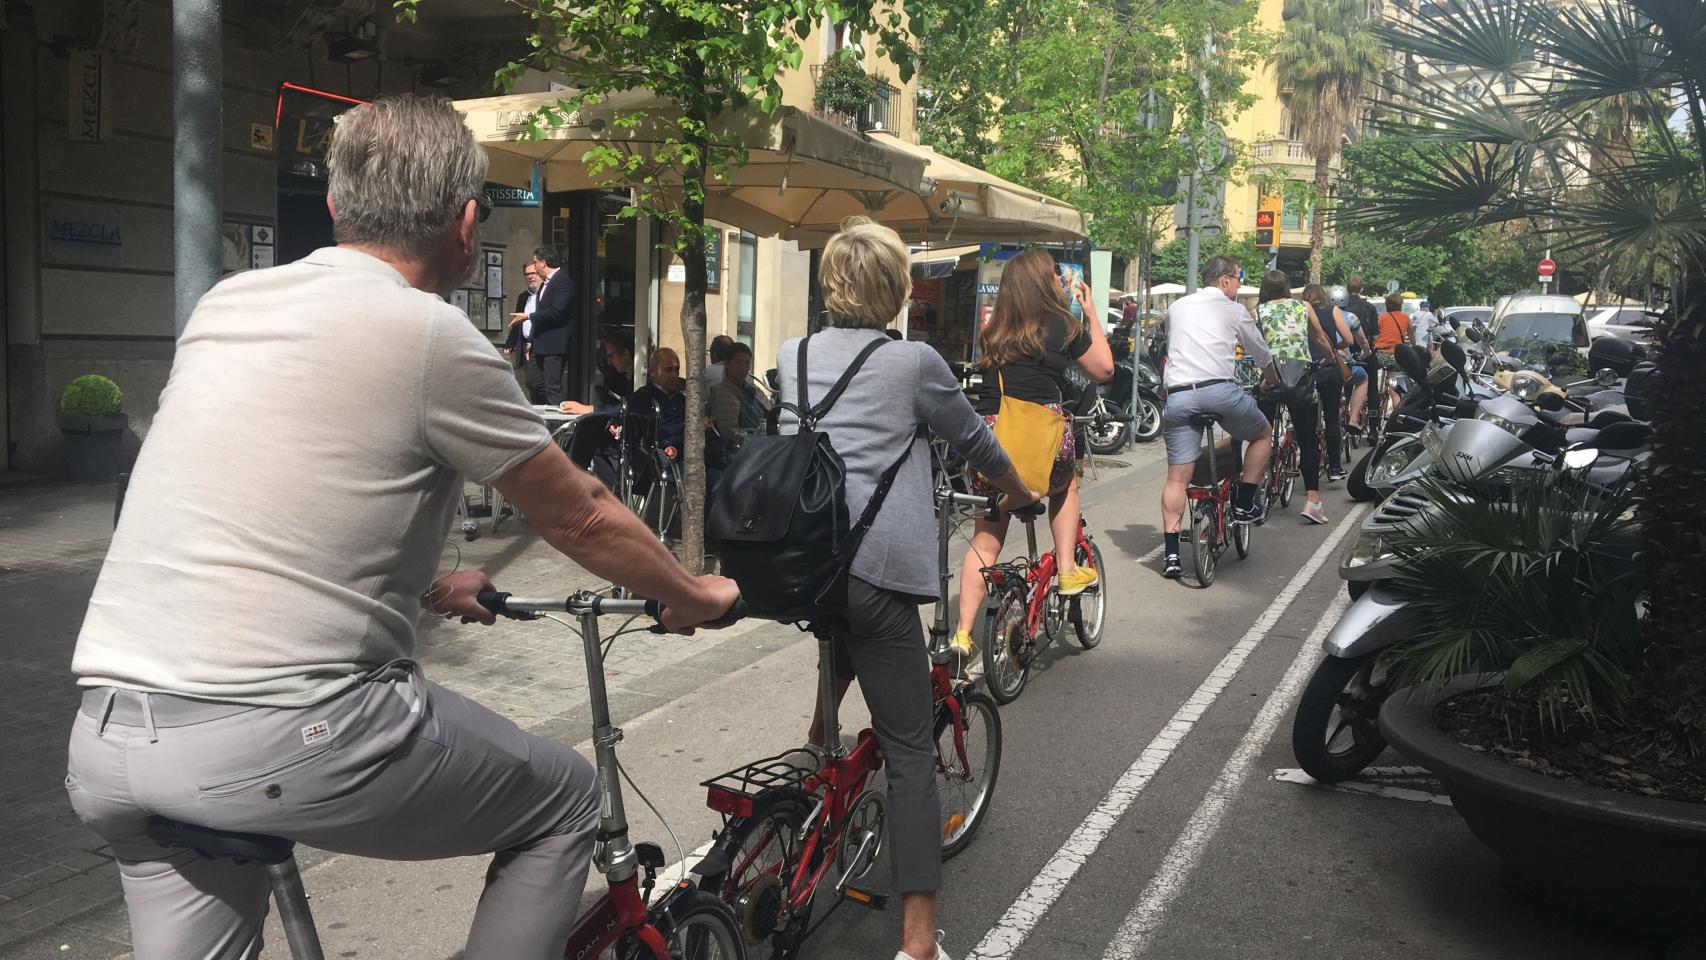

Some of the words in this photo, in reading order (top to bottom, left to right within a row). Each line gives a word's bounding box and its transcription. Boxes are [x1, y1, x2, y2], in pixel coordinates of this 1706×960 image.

[82, 52, 98, 138] MEZCL
[51, 219, 121, 241] MEZCLA
[576, 919, 617, 960] DAHN
